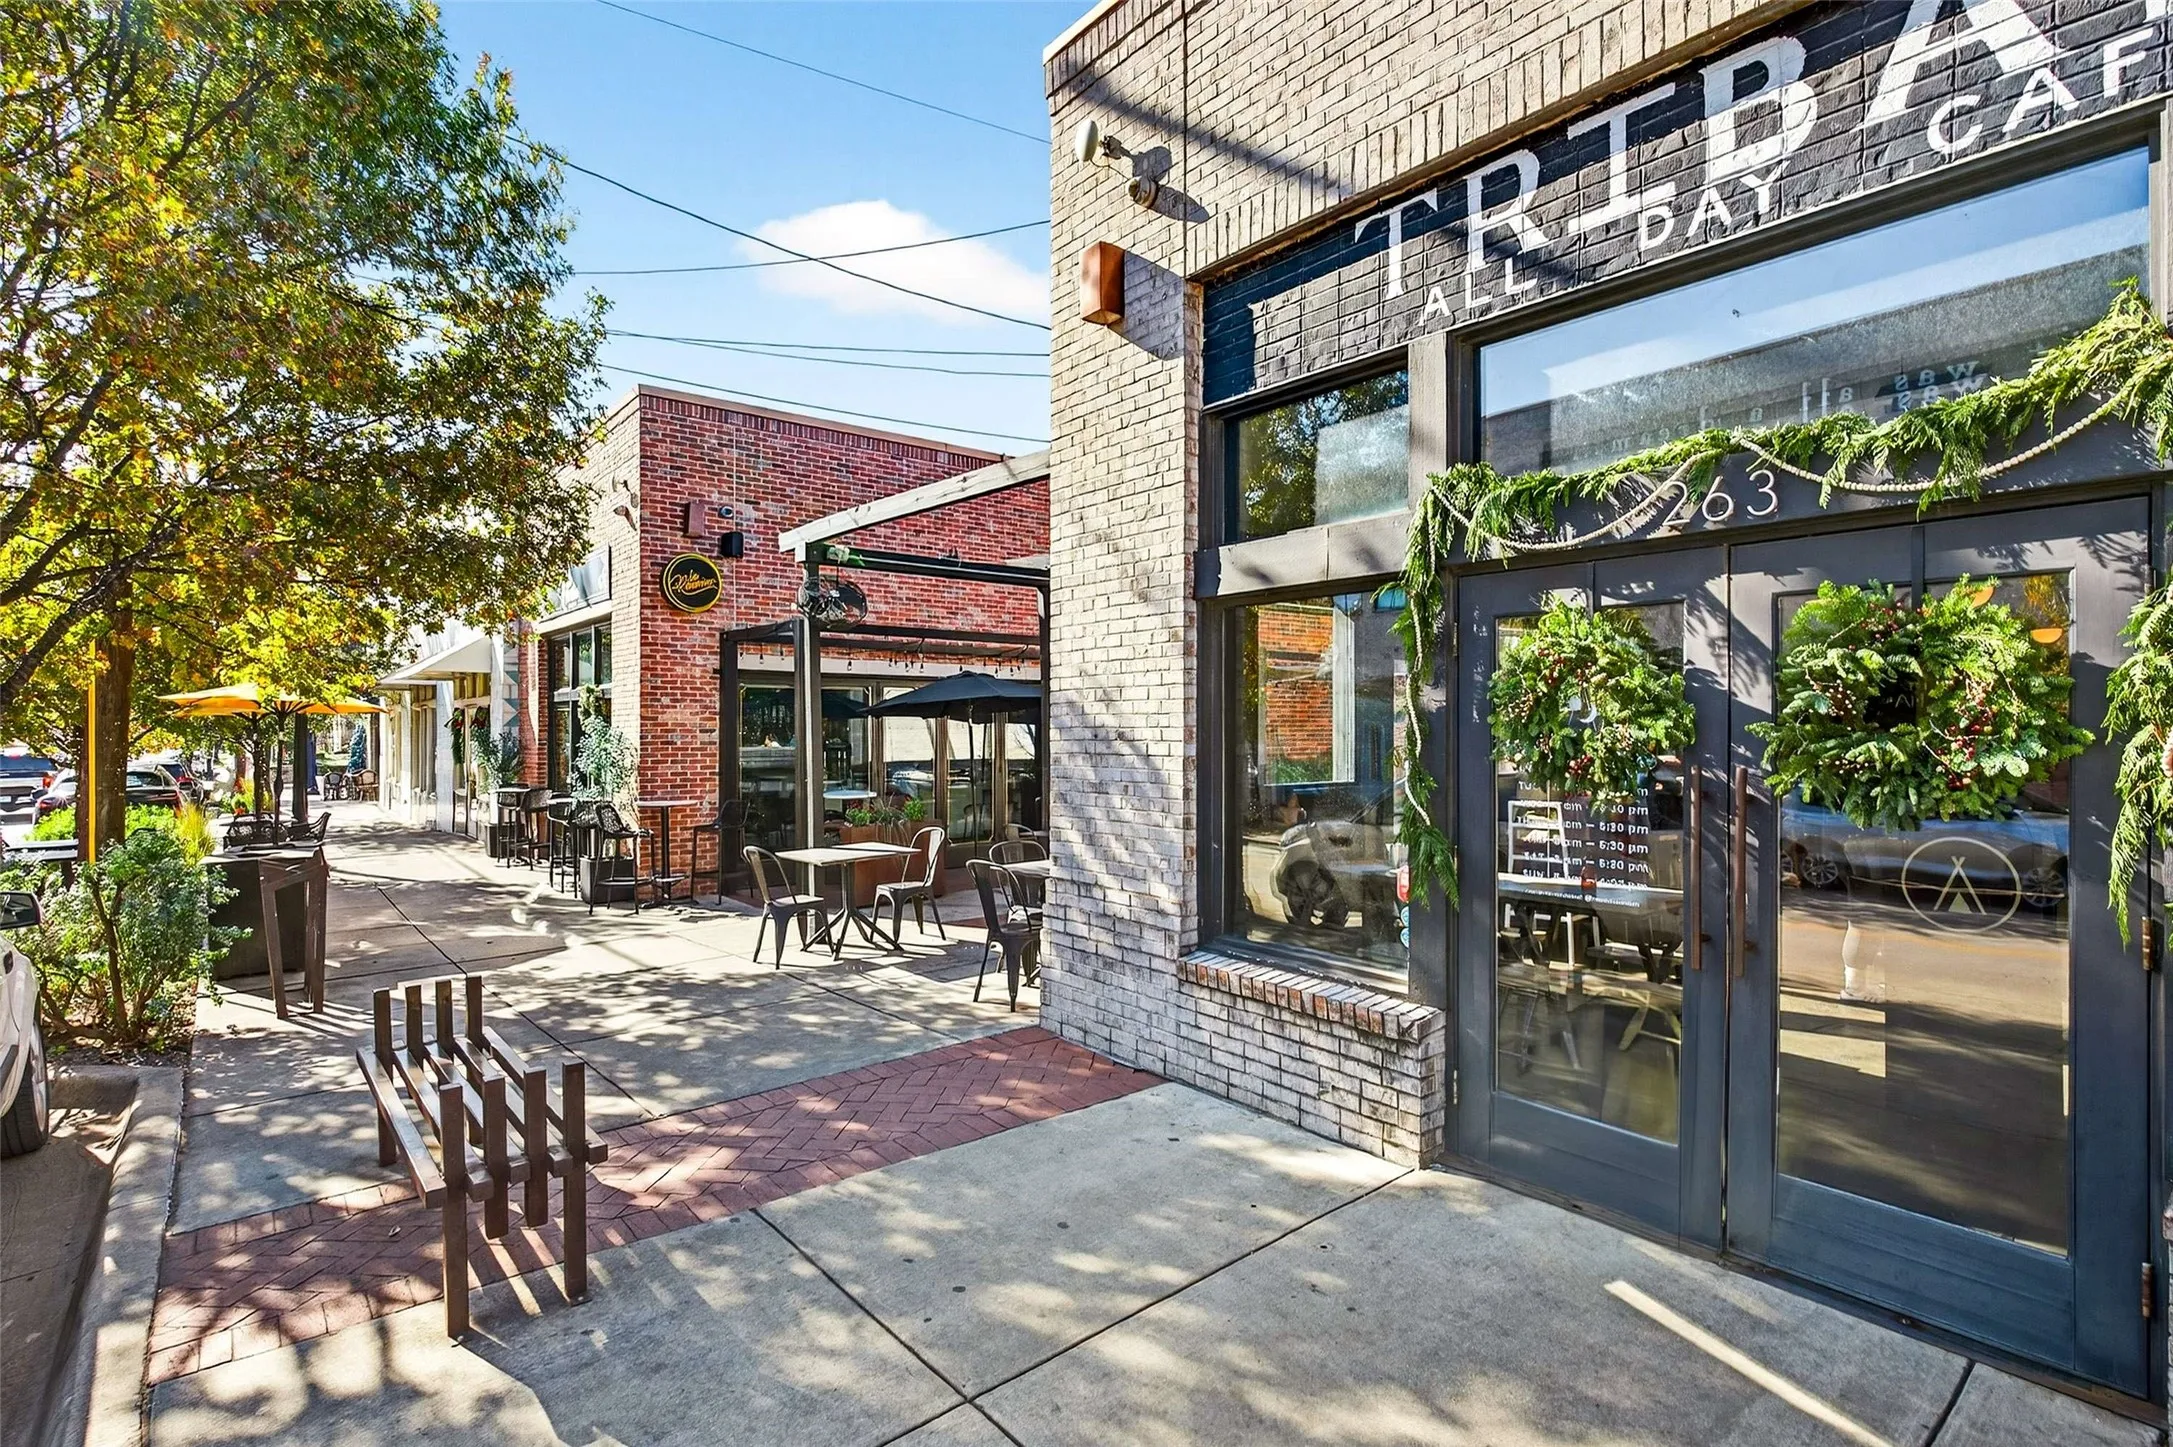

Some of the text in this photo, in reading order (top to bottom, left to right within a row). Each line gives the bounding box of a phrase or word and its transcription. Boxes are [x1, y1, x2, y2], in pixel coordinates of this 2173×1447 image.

[1354, 0, 2173, 300] TRIBA
[1417, 257, 1537, 326] ALL
[1638, 160, 1791, 250] DAY
[1663, 468, 1778, 526] 263
[1628, 806, 1649, 816] pm
[1628, 825, 1649, 836] pm
